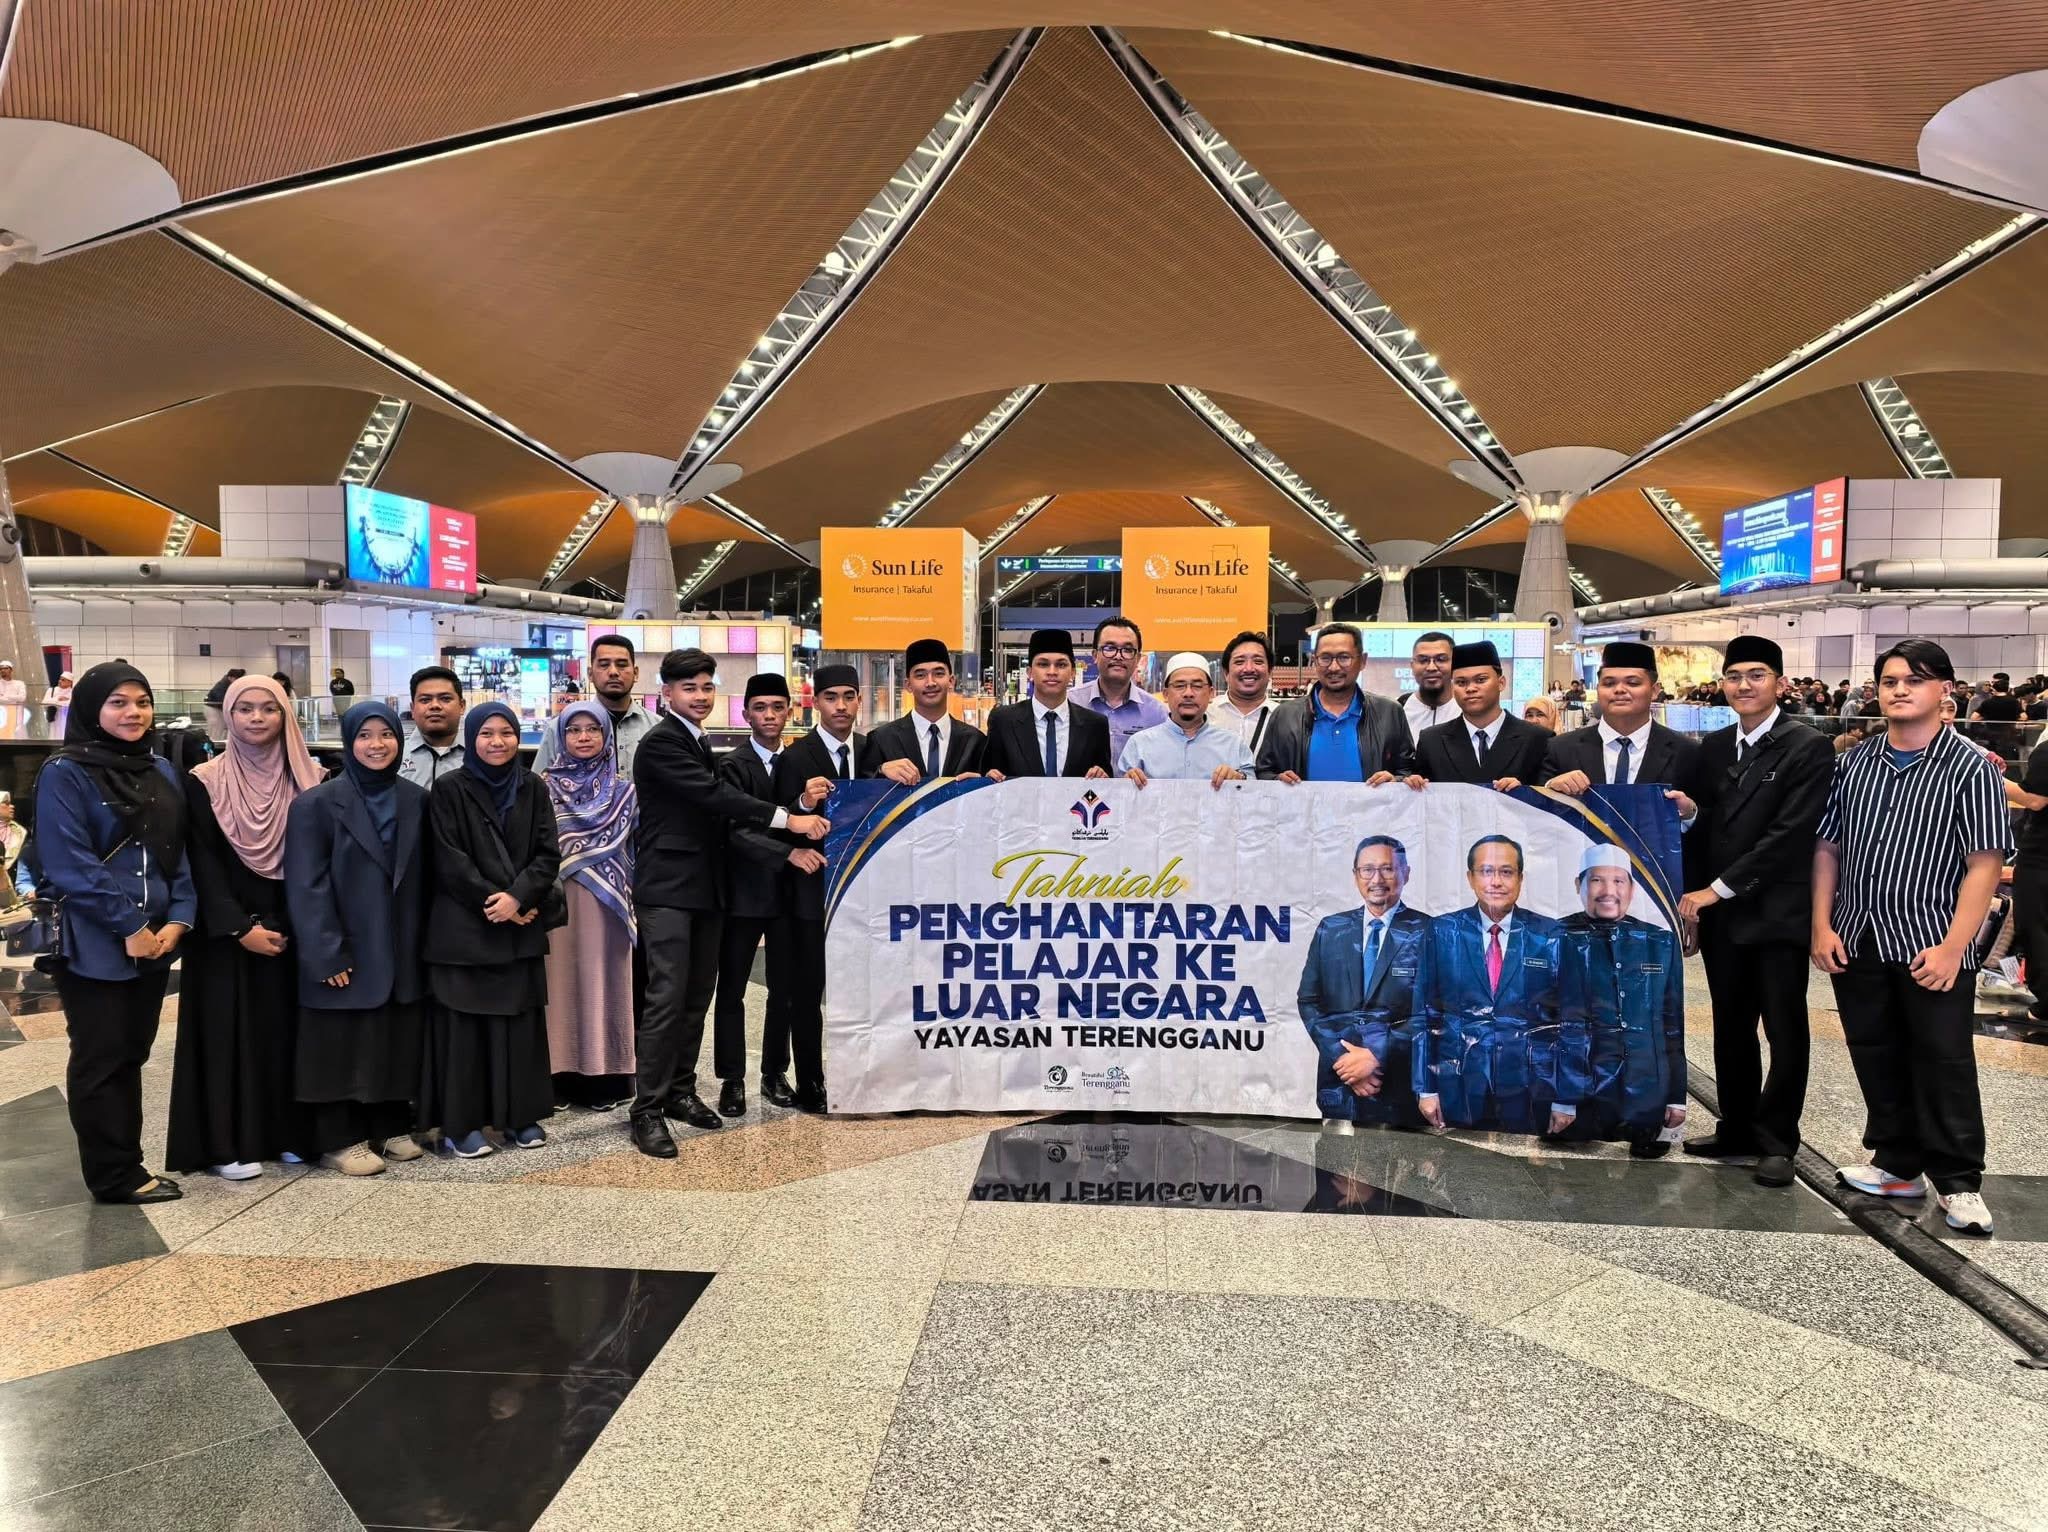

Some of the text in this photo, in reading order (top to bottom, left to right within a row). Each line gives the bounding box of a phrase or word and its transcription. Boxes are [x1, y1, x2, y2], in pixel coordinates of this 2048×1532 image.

[871, 558, 944, 576] Sun Life
[1174, 558, 1249, 577] Sun Life
[853, 585, 933, 594] Insurance Takaful
[1155, 585, 1238, 595] Insurance Takaful
[992, 849, 1185, 907] Tahniah
[889, 902, 1291, 943] PENGHANTARAN
[942, 942, 1236, 981] PELAJAR KE
[912, 983, 1267, 1023] LUAR NEGARA
[914, 1025, 1265, 1052] YAYASAN TERENGGANU
[1082, 1078, 1131, 1089] Terengganu
